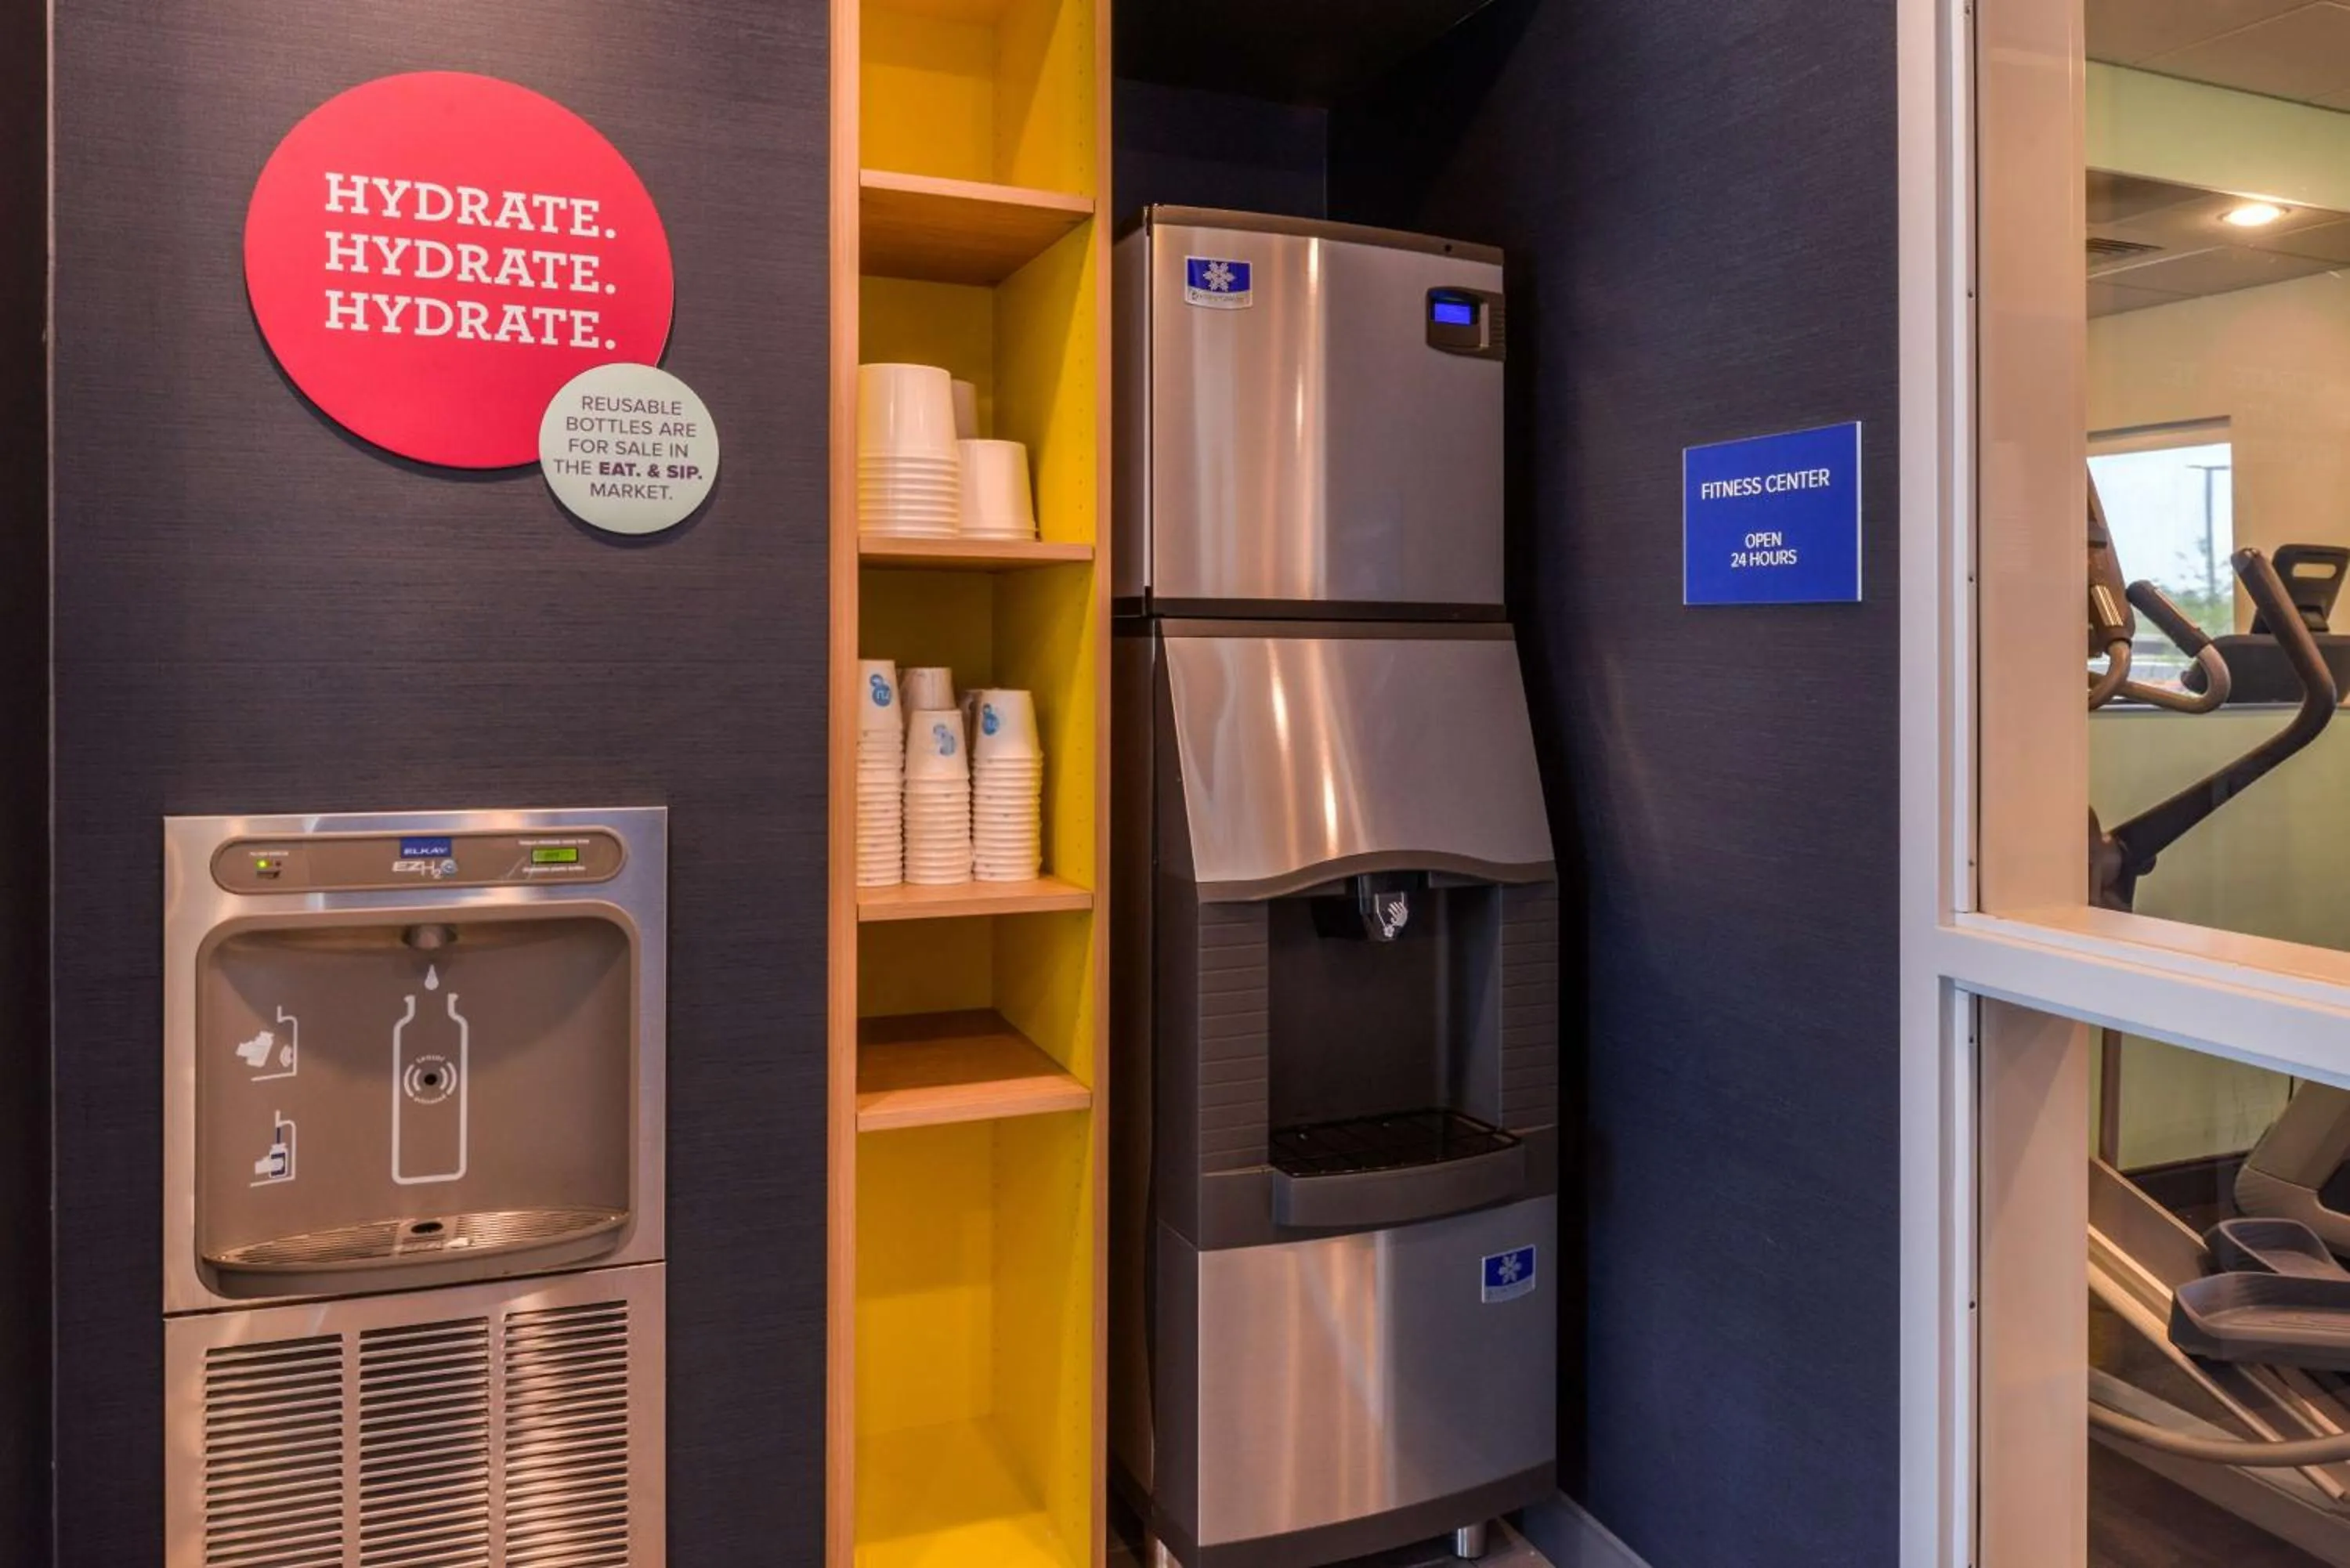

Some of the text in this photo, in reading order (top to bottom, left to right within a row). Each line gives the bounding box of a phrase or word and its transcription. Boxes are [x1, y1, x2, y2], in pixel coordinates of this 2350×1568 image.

[325, 172, 616, 239] HYDRATE.
[325, 230, 616, 294] HYDRATE.
[325, 289, 616, 350] HYDRATE.
[582, 396, 682, 416] REUSABLE
[566, 416, 696, 438] BOTTLES ARE
[569, 438, 689, 458] FOR SALE IN
[553, 458, 703, 480] THE EAT. & SIP.
[590, 482, 673, 500] MARKET.
[1701, 468, 1831, 500] FITNESS CENTER
[1744, 531, 1782, 549] OPEN
[1730, 549, 1797, 568] 24 HOURS
[403, 847, 447, 855] ELKAY
